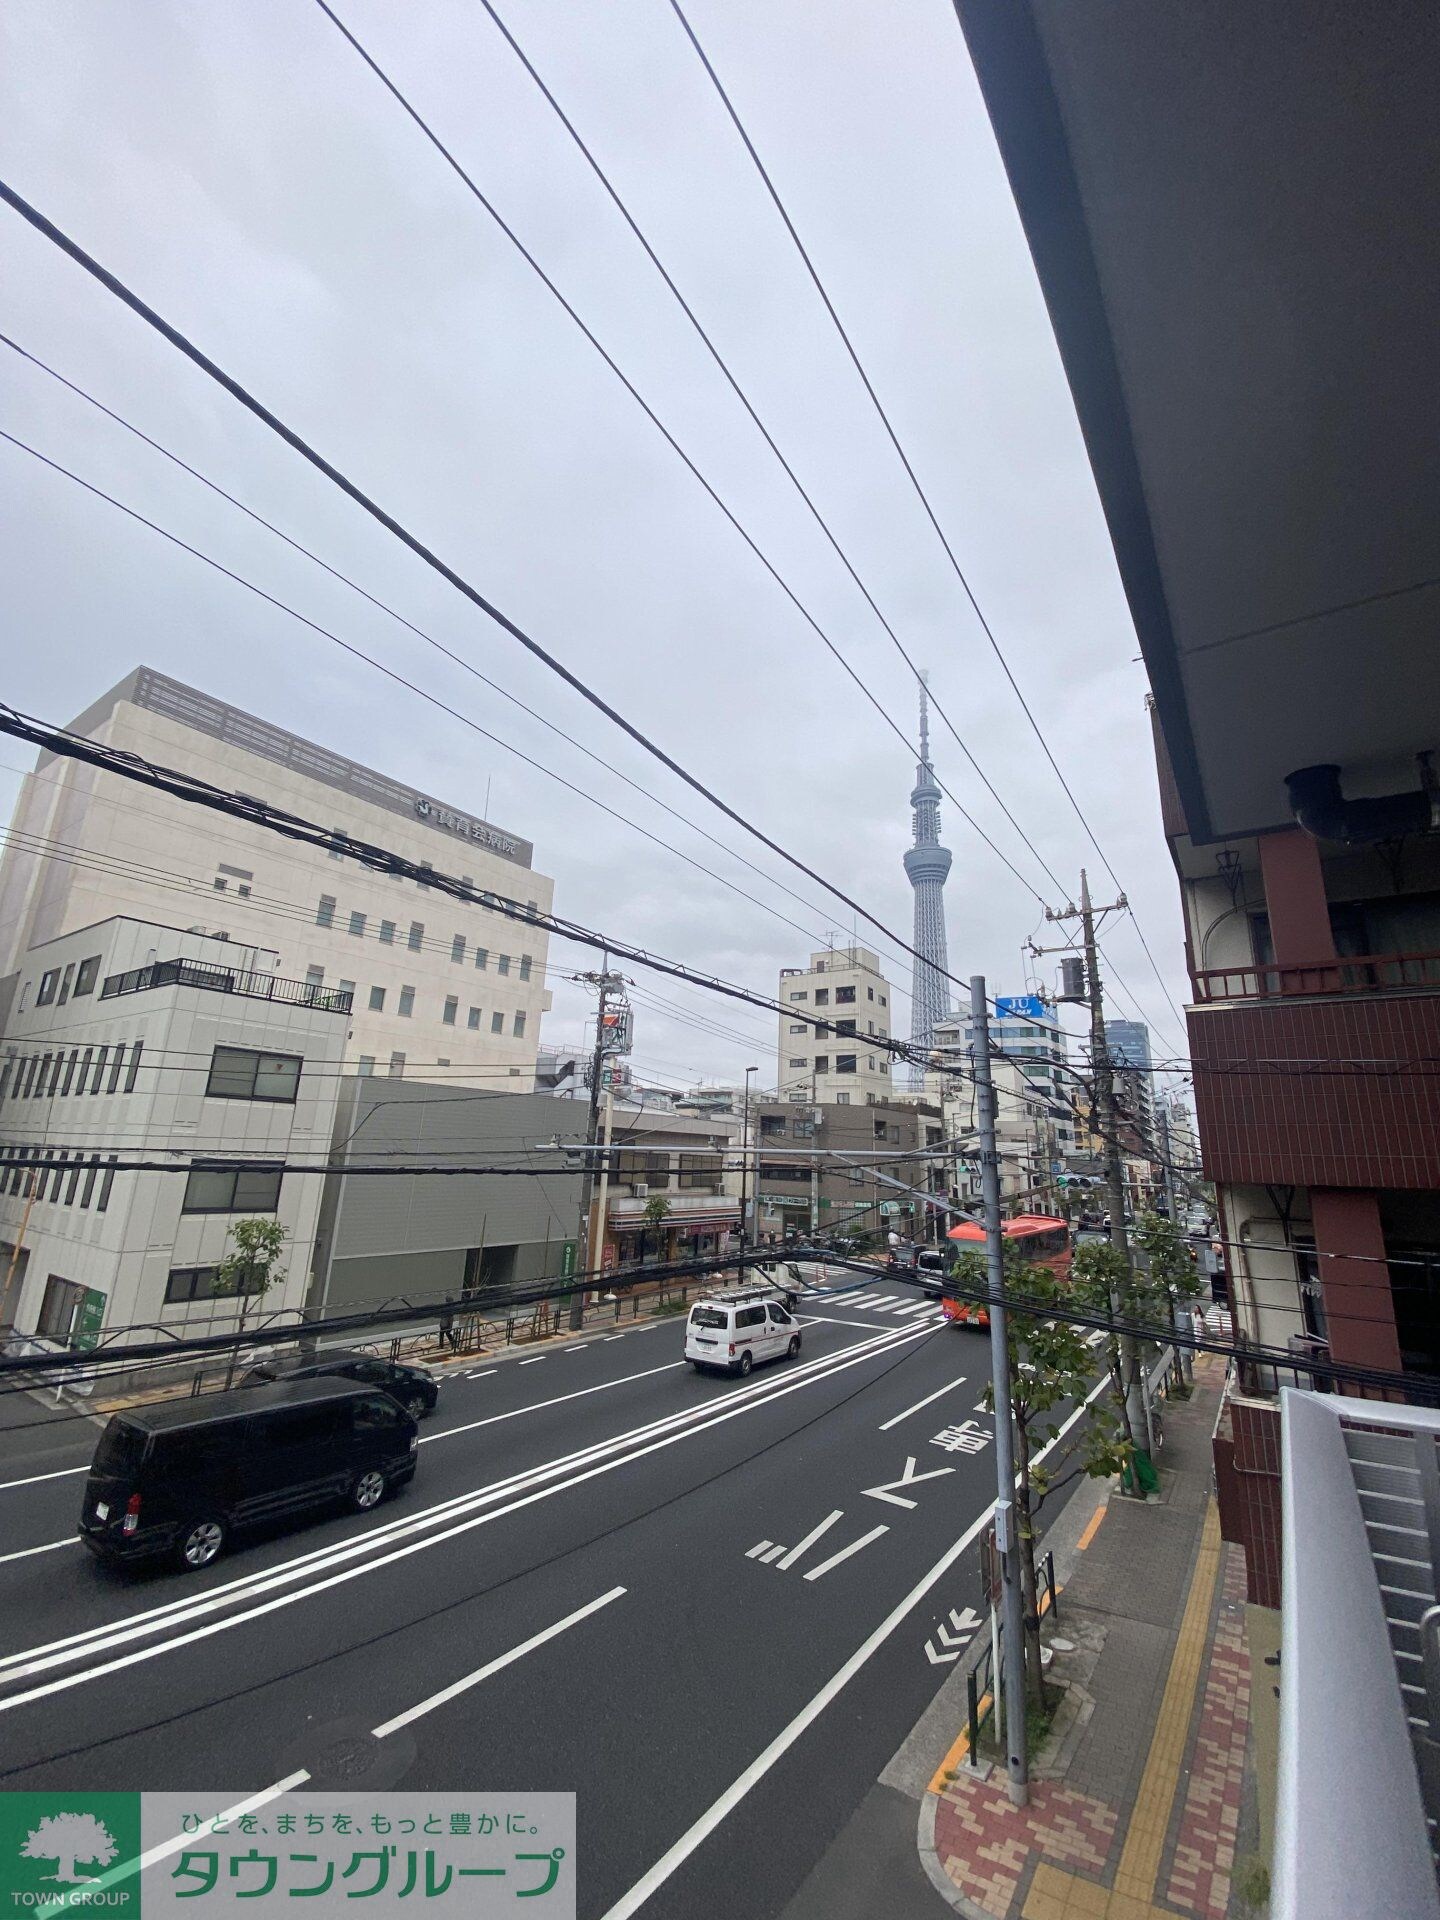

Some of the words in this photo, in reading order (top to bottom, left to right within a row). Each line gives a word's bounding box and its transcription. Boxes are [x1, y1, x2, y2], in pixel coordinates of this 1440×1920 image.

[437, 810, 516, 855] 賛育会病院
[1008, 998, 1030, 1010] JU
